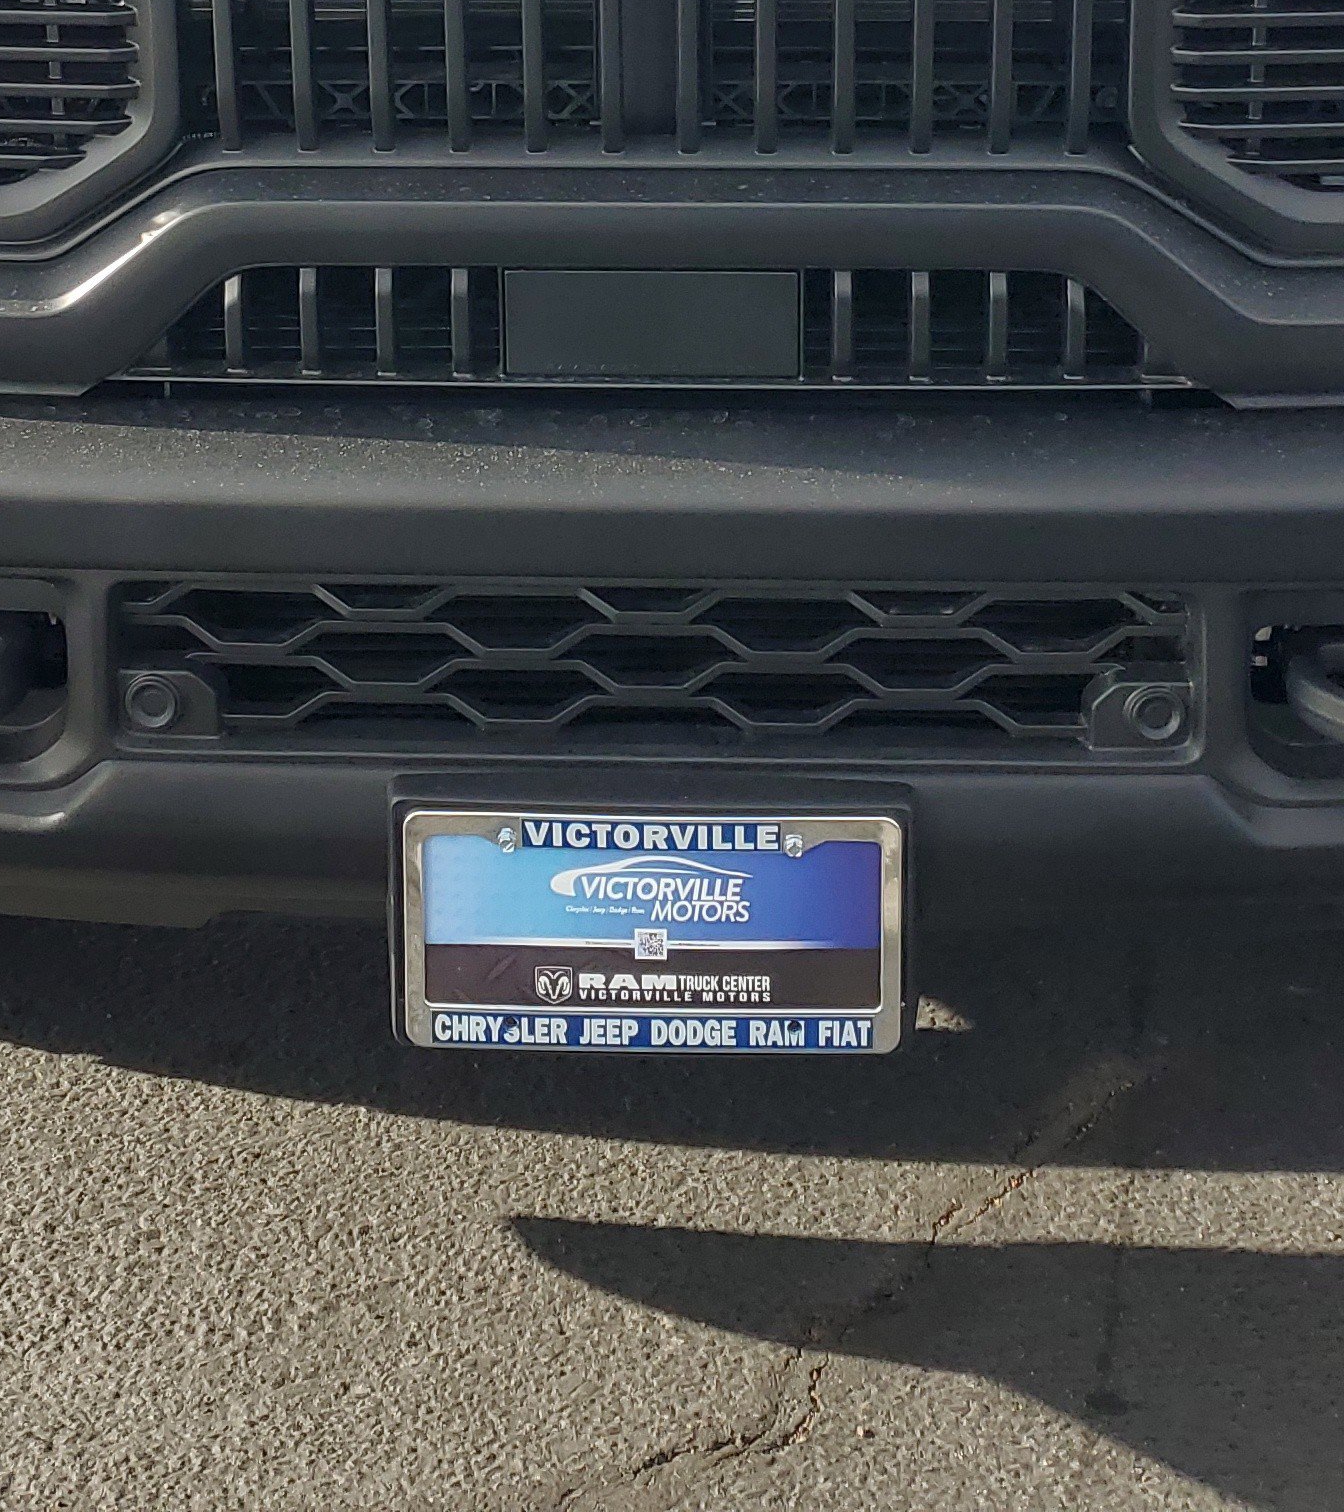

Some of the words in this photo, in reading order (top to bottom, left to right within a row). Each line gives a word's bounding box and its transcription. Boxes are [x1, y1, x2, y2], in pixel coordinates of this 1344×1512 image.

[524, 821, 779, 850] VICTORVILLE
[581, 876, 743, 901] VICTORVILLE
[650, 900, 751, 922] MOTORS
[578, 973, 677, 990] RAM
[678, 975, 719, 991] TRUCK
[722, 975, 771, 991] CENTER
[579, 989, 693, 1002] VICTORVILLE
[703, 991, 771, 1002] MOTORS
[579, 1017, 639, 1045] JEEP
[650, 1019, 737, 1046] DODGE
[749, 1019, 805, 1046] RAM
[818, 1020, 871, 1047] FIAT
